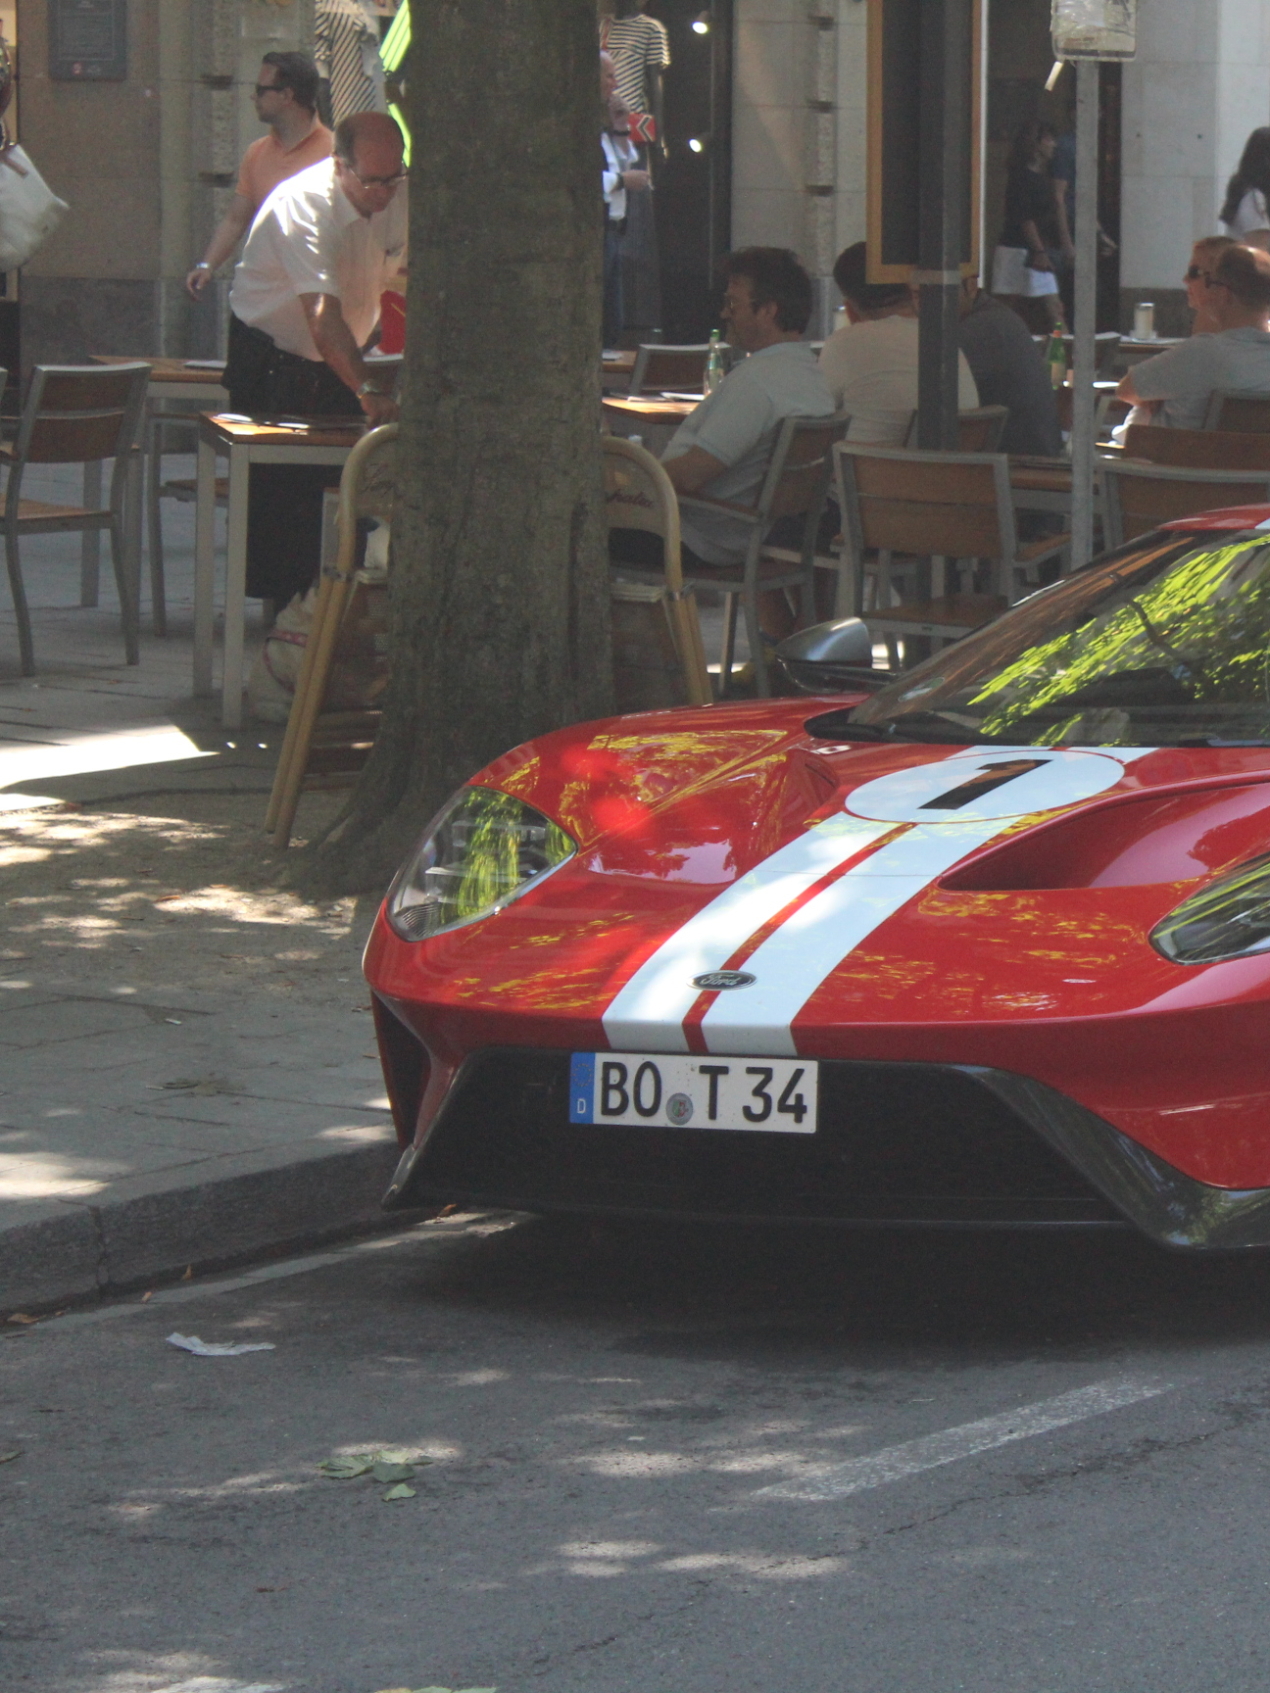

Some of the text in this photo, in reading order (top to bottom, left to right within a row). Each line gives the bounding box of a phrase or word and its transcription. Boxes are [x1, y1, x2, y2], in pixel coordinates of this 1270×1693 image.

[577, 1098, 586, 1114] D
[601, 1061, 808, 1124] BO T 34
